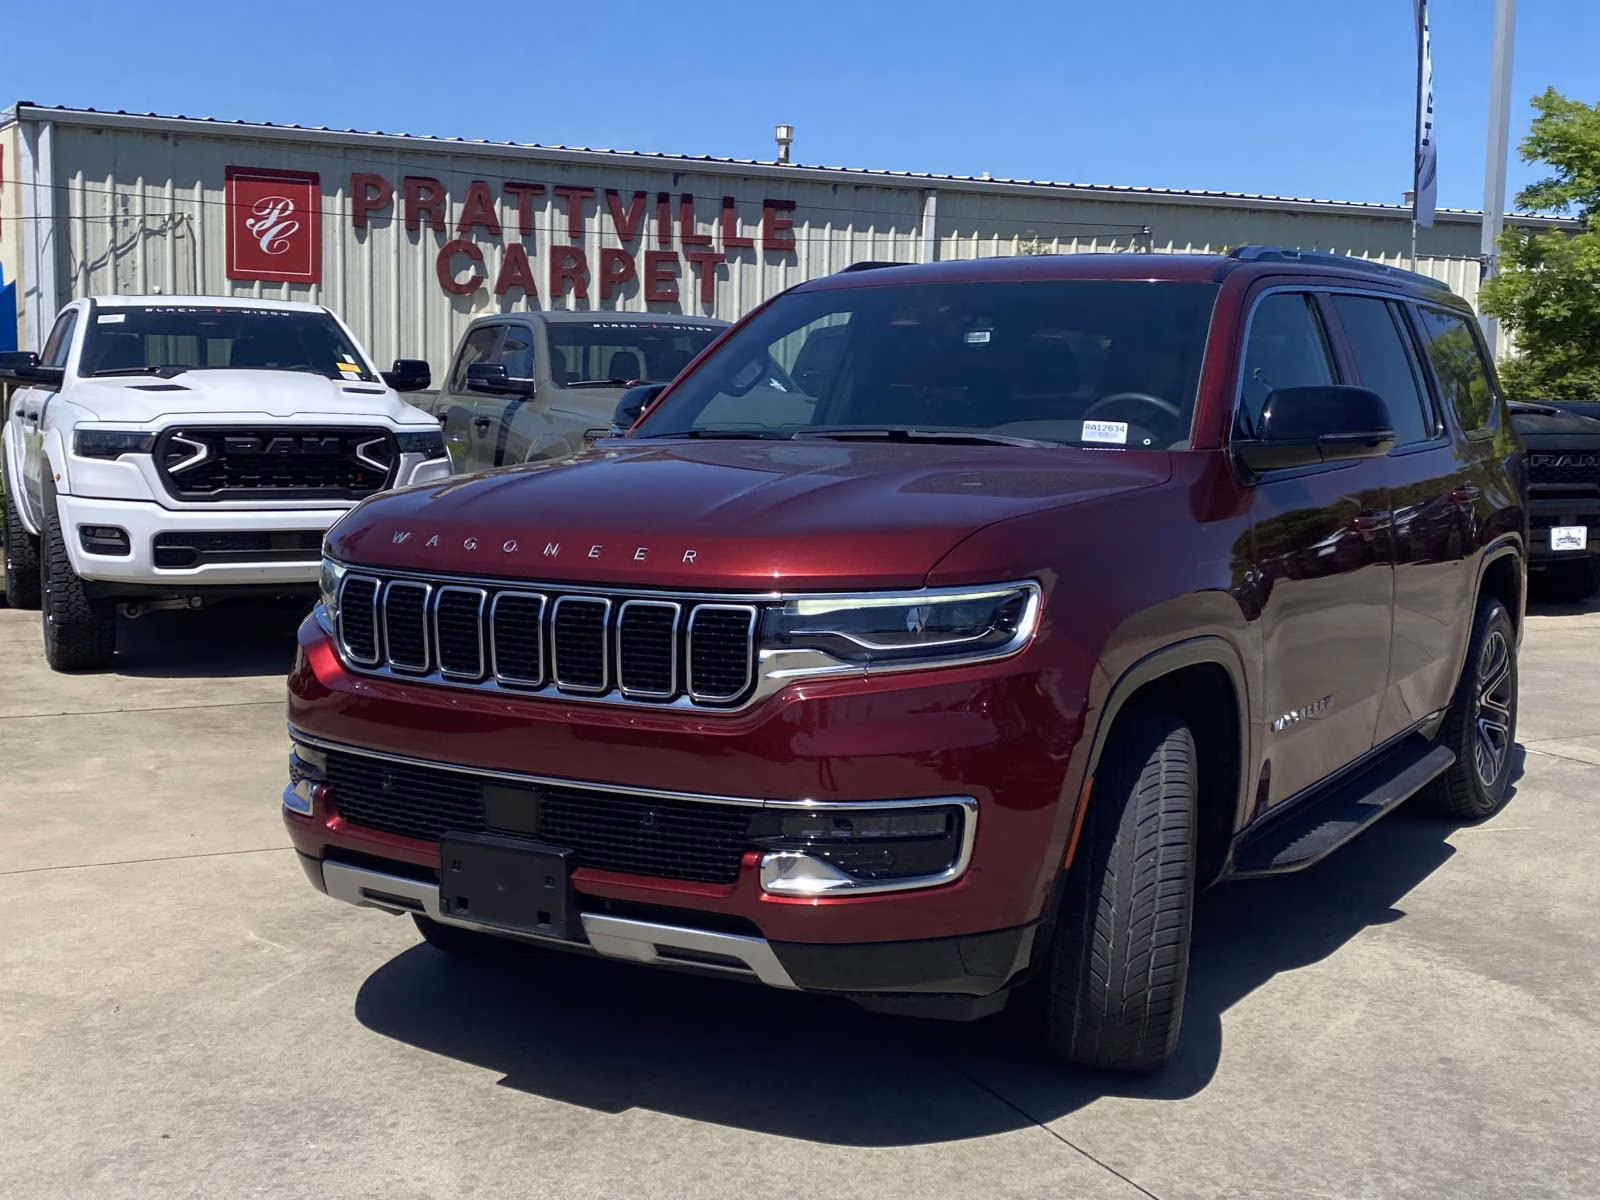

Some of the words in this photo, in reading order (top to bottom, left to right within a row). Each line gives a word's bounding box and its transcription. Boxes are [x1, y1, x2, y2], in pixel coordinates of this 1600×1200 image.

[350, 172, 796, 250] PRATTVILLE
[436, 239, 726, 303] CARPET
[1085, 423, 1125, 433] RA12634
[392, 531, 698, 564] WAGONEER
